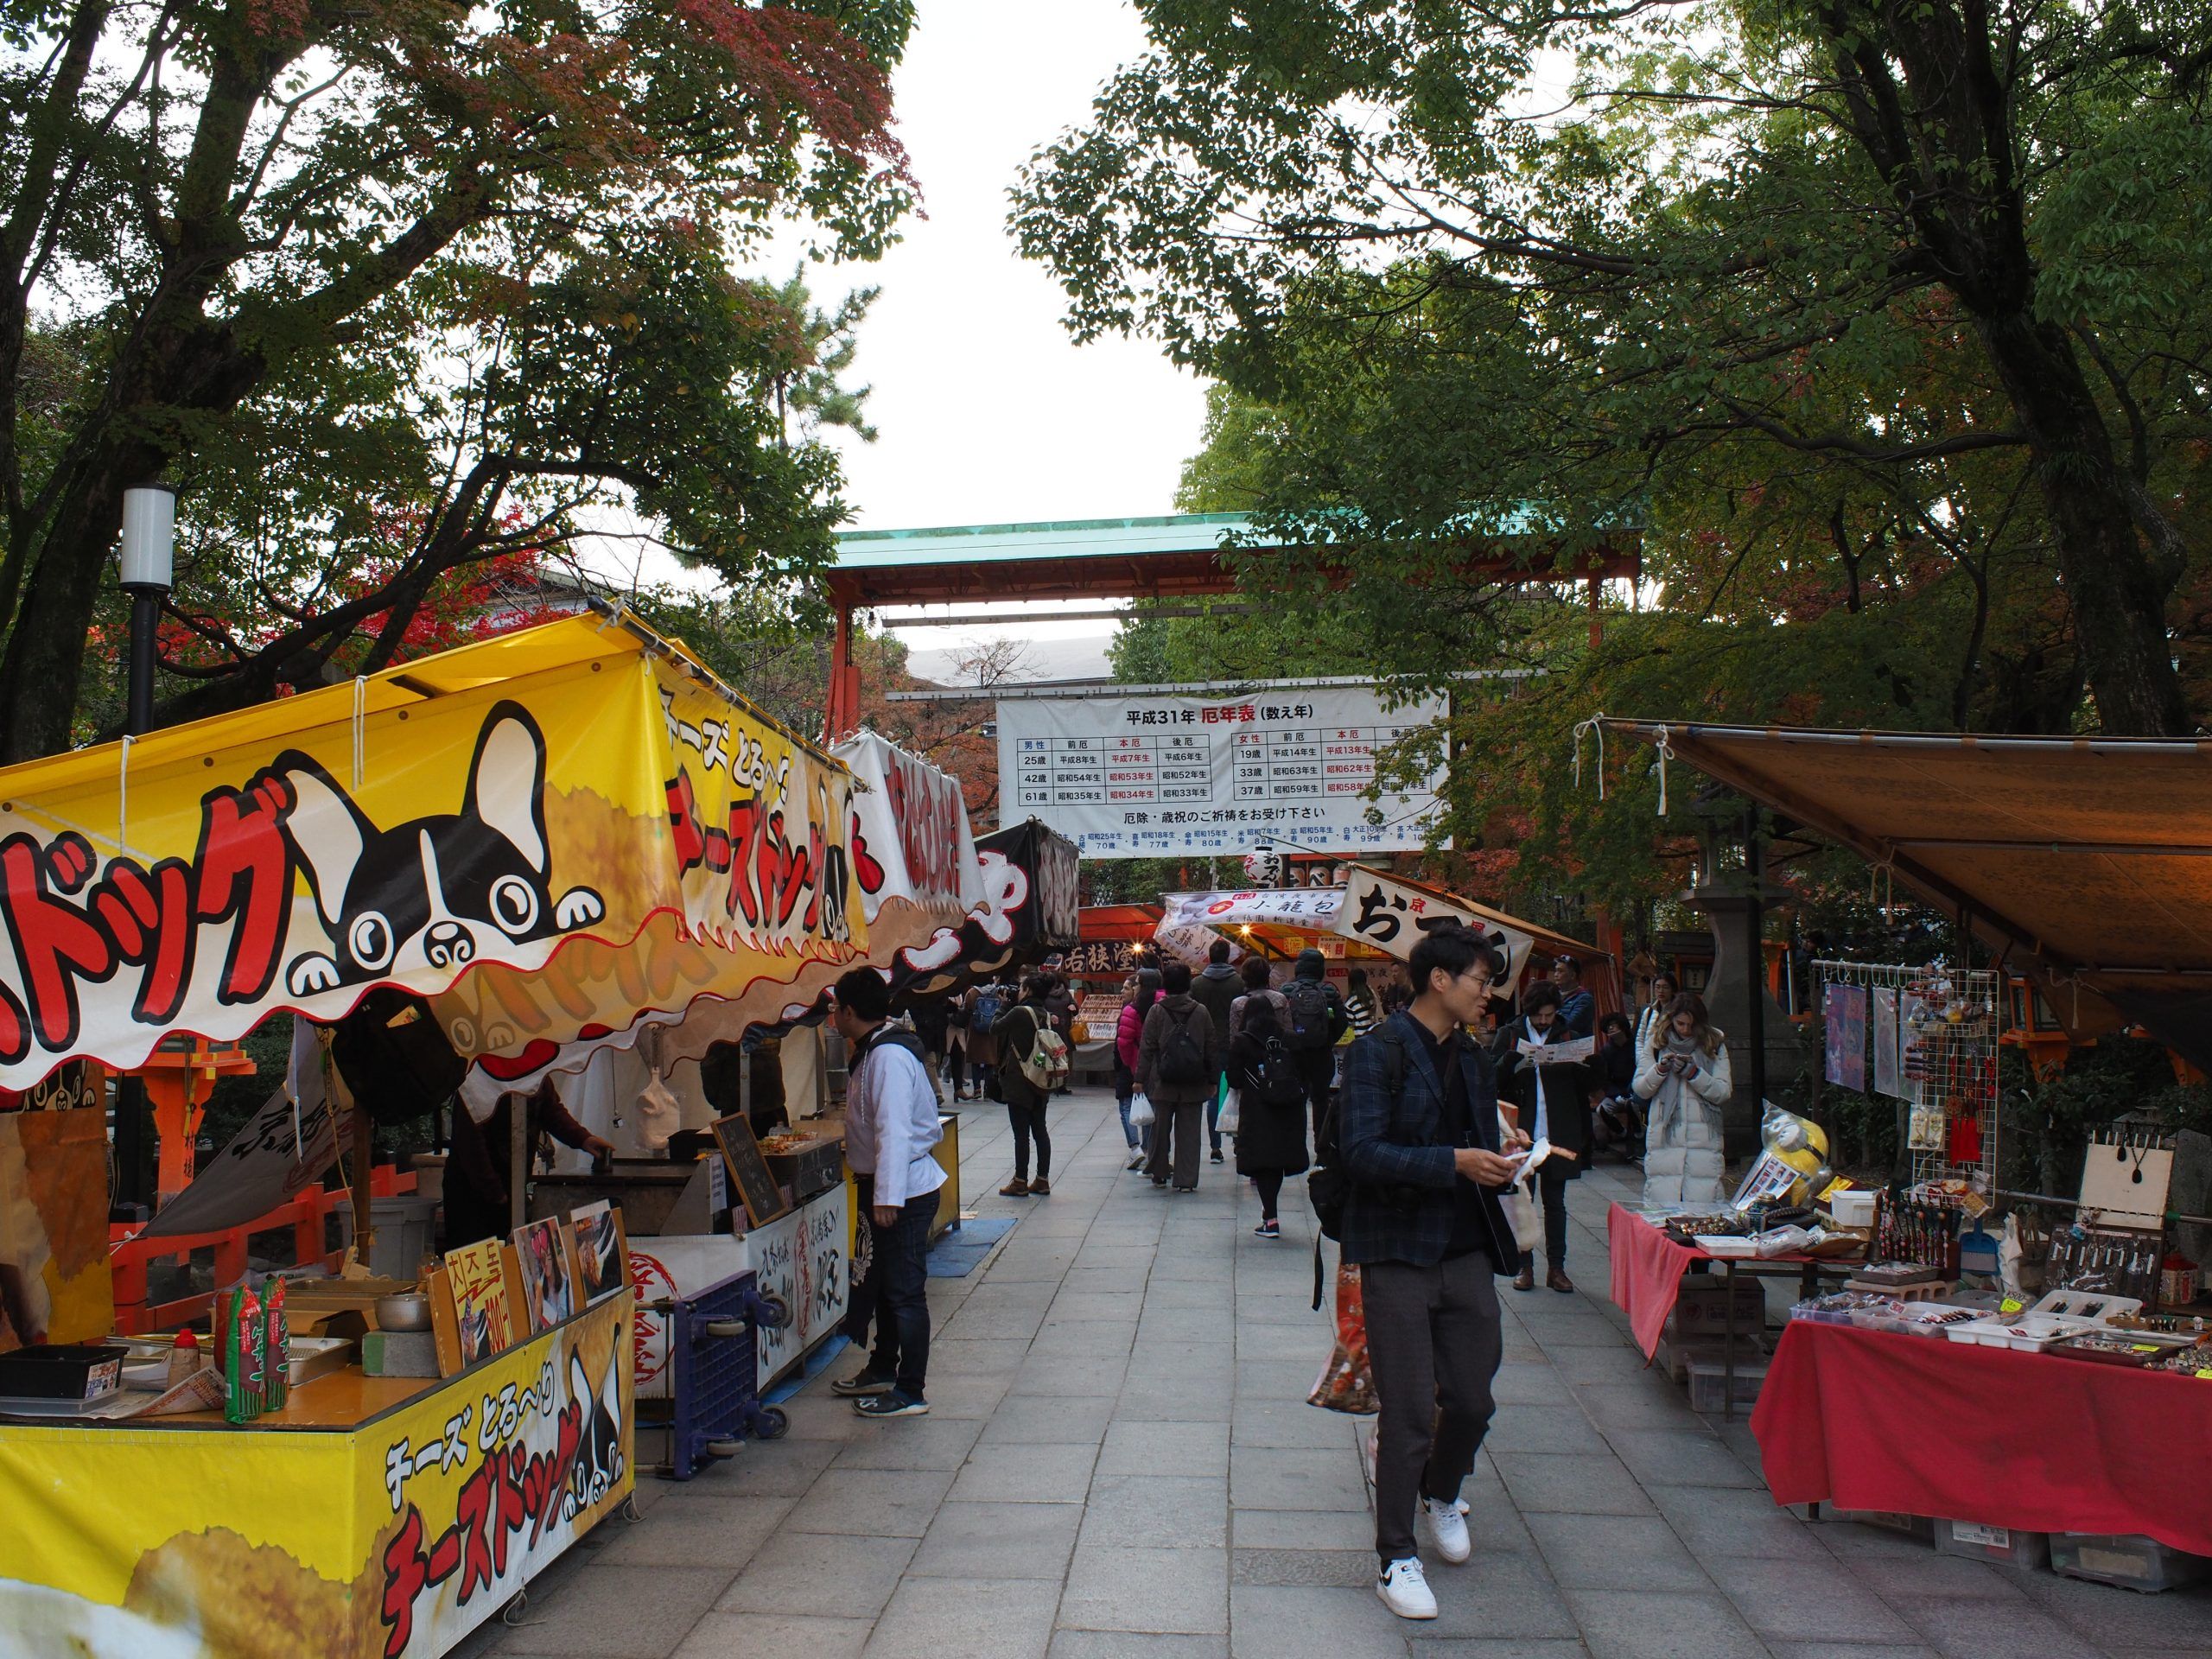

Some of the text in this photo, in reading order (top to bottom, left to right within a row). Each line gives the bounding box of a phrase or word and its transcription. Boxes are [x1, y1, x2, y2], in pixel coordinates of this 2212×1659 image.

[1126, 709, 1196, 726] 平成31年
[1201, 705, 1255, 724] 厄年表
[1239, 734, 1261, 744] 女性
[1283, 733, 1305, 742] 前厄
[1337, 729, 1359, 740] 本厄
[1024, 737, 1193, 750] 男性 前厄 本厄 後厄
[1024, 753, 1203, 765] 25歳 平成8年生 平成7年生 平成6年生
[1240, 746, 1370, 759] 19歳 平成14年生 平成13年生
[1024, 770, 1207, 783] 42歳 昭和54年生 昭和53年生 昭和52年生
[1240, 768, 1262, 777] 33歳
[1273, 766, 1318, 775] 昭和63年生
[1326, 764, 1372, 774] 昭和62年生
[1025, 788, 1208, 801] 61歳 昭和35年生 昭和34年生 昭和33年生
[1241, 786, 1263, 795] 37歳
[1274, 785, 1319, 793] 昭和59年生
[1261, 852, 1280, 882] おでん
[1247, 900, 1334, 914] 小籠包
[0, 764, 298, 1066] ドッグ
[386, 1403, 472, 1513] チーズ
[380, 1396, 582, 1659] チーズドッグ
